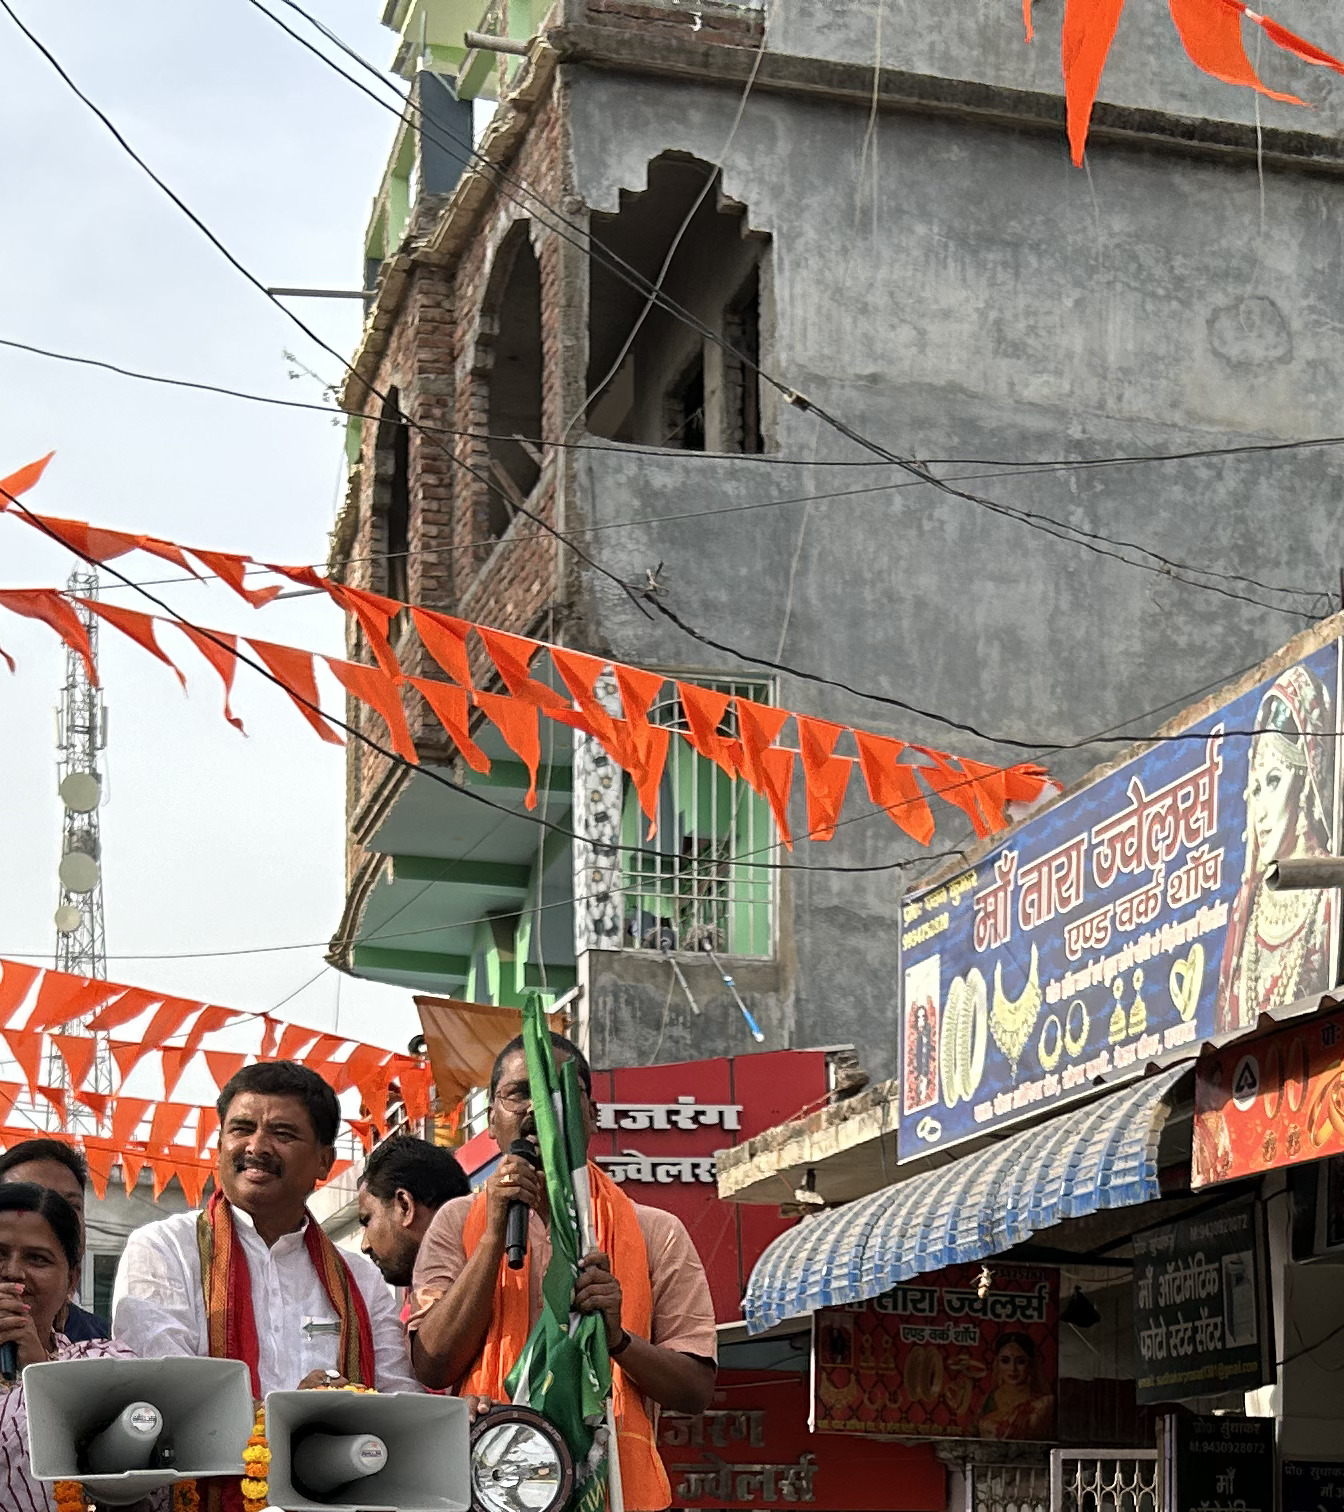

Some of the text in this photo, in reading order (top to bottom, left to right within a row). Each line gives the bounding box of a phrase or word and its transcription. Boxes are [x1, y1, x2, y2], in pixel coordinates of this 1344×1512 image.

[972, 848, 1016, 955] माँ
[1017, 835, 1088, 932] तारा
[1090, 722, 1225, 890] ज्वेलर्स
[1064, 903, 1113, 961] एण्ड
[1116, 871, 1165, 932] वर्क
[1167, 846, 1223, 909] शॉप
[1137, 1263, 1154, 1310] माँ
[900, 1322, 980, 1346] एण्ड वर्क शॉप
[1140, 1314, 1167, 1361] फोटो
[659, 1393, 767, 1447] जरंग
[672, 1452, 818, 1503] ज्वेलर्स
[1216, 1466, 1236, 1496] माँ
